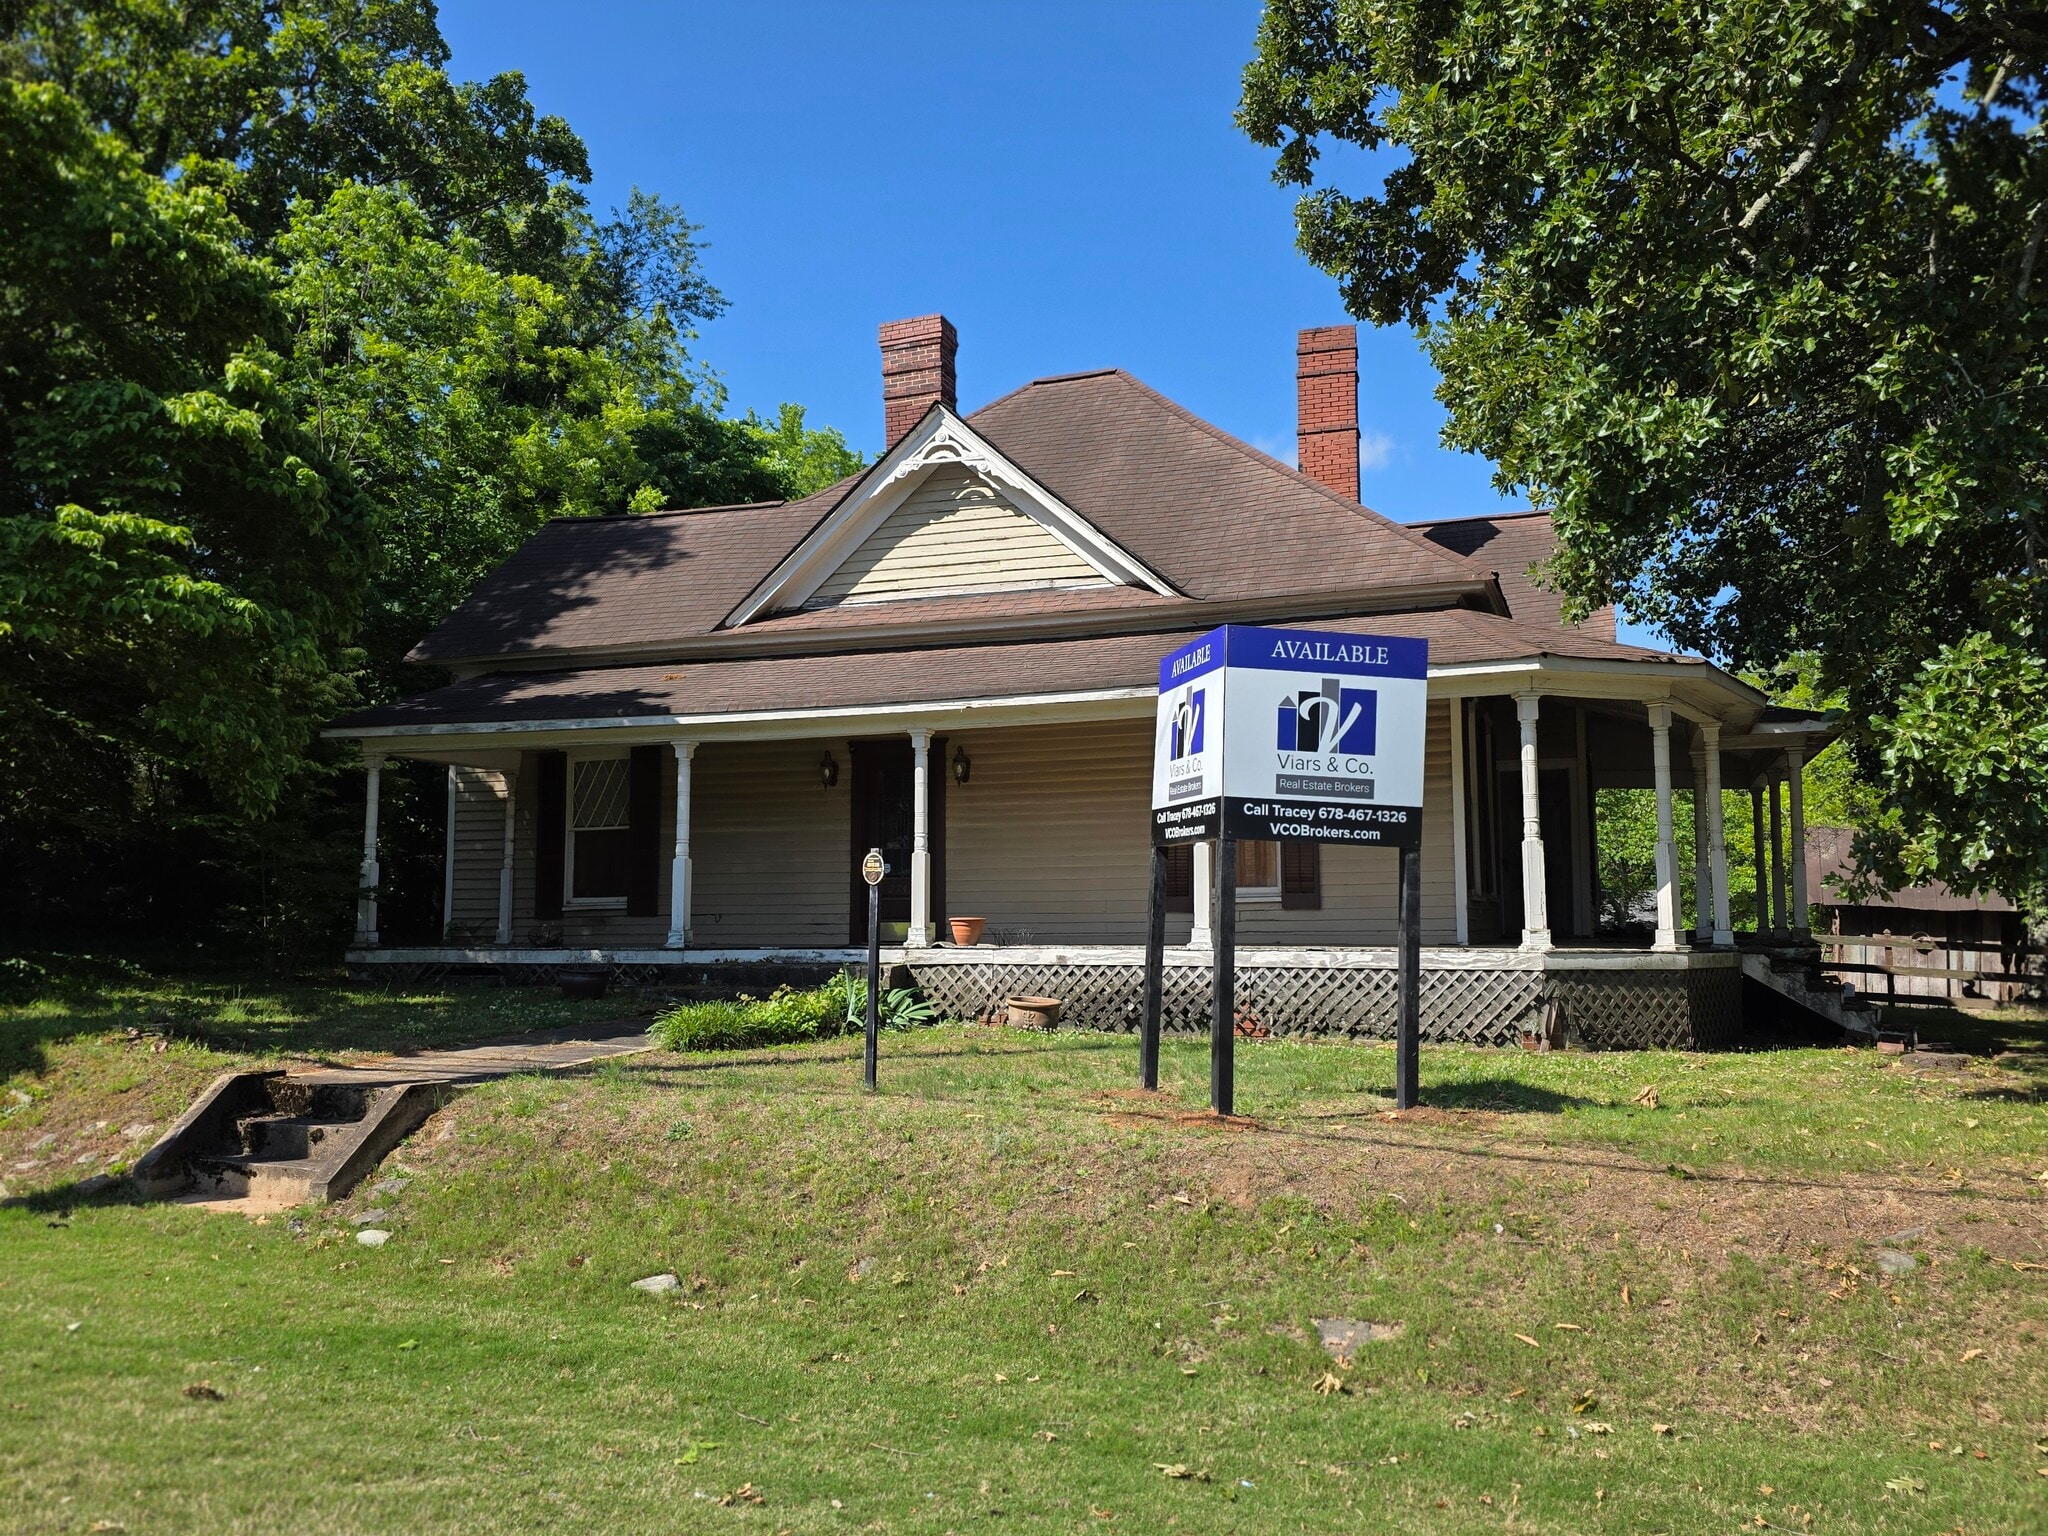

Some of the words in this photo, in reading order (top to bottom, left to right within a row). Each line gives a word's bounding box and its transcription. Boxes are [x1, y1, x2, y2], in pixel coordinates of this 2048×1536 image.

[1171, 644, 1210, 678] AVAILABLE
[1271, 640, 1389, 665] AVAILABLE
[1192, 757, 1203, 772] Co.
[1277, 754, 1320, 771] Viars
[1327, 757, 1339, 771] &
[1345, 758, 1373, 775] Co.
[1280, 779, 1300, 789] Real
[1303, 780, 1332, 791] Estate
[1335, 782, 1370, 793] Brokers
[1157, 811, 1166, 824] Call
[1167, 809, 1181, 823] Tracey
[1182, 802, 1215, 821] 678-467-1326
[1244, 803, 1268, 816] Call
[1273, 805, 1315, 821] Tracey
[1318, 807, 1407, 823] 678-467-1326
[1165, 824, 1205, 839] VCOBrokers.com
[1270, 823, 1380, 840] VCOBrokers.com
